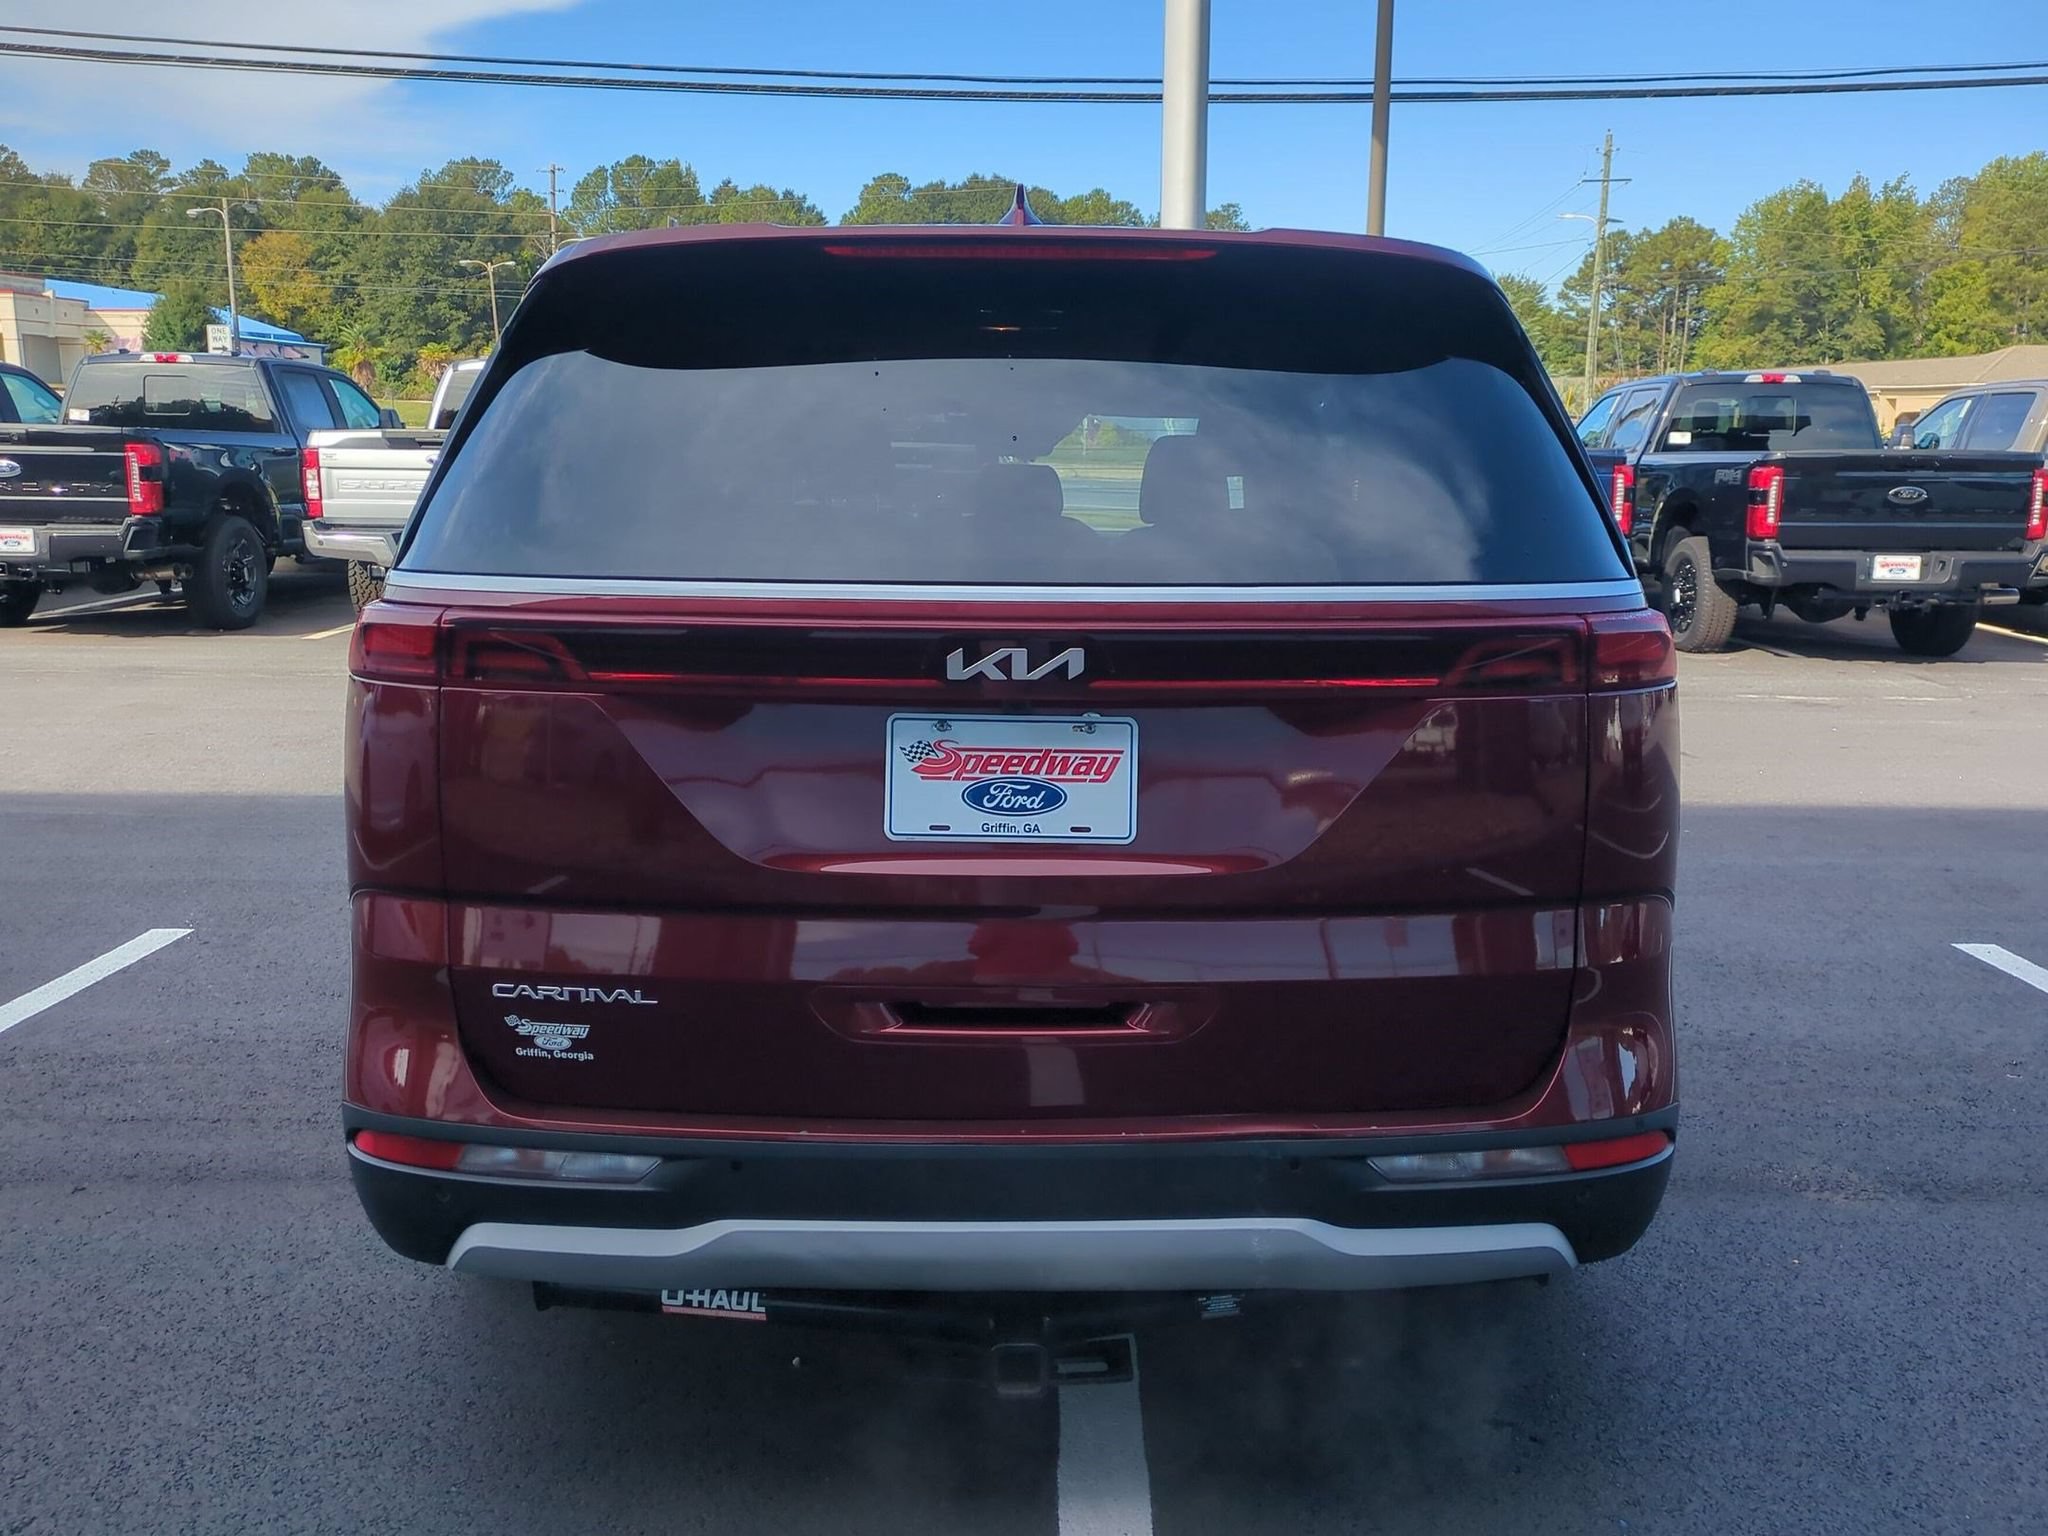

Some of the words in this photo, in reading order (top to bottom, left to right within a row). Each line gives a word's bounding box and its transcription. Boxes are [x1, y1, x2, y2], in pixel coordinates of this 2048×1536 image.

[211, 327, 227, 335] ONE
[212, 335, 228, 343] WAY
[946, 647, 1085, 681] KIA
[911, 739, 1125, 783] Speedway
[982, 783, 1047, 810] Ford
[981, 822, 1020, 835] Griffin,
[1023, 823, 1041, 834] GA
[492, 983, 658, 1004] CARNIVAL
[515, 1018, 590, 1039] Speedway
[541, 1037, 564, 1048] Ford
[515, 1047, 551, 1059] Griffin,
[553, 1049, 594, 1061] Georgia
[661, 1288, 766, 1313] U-HAUL
